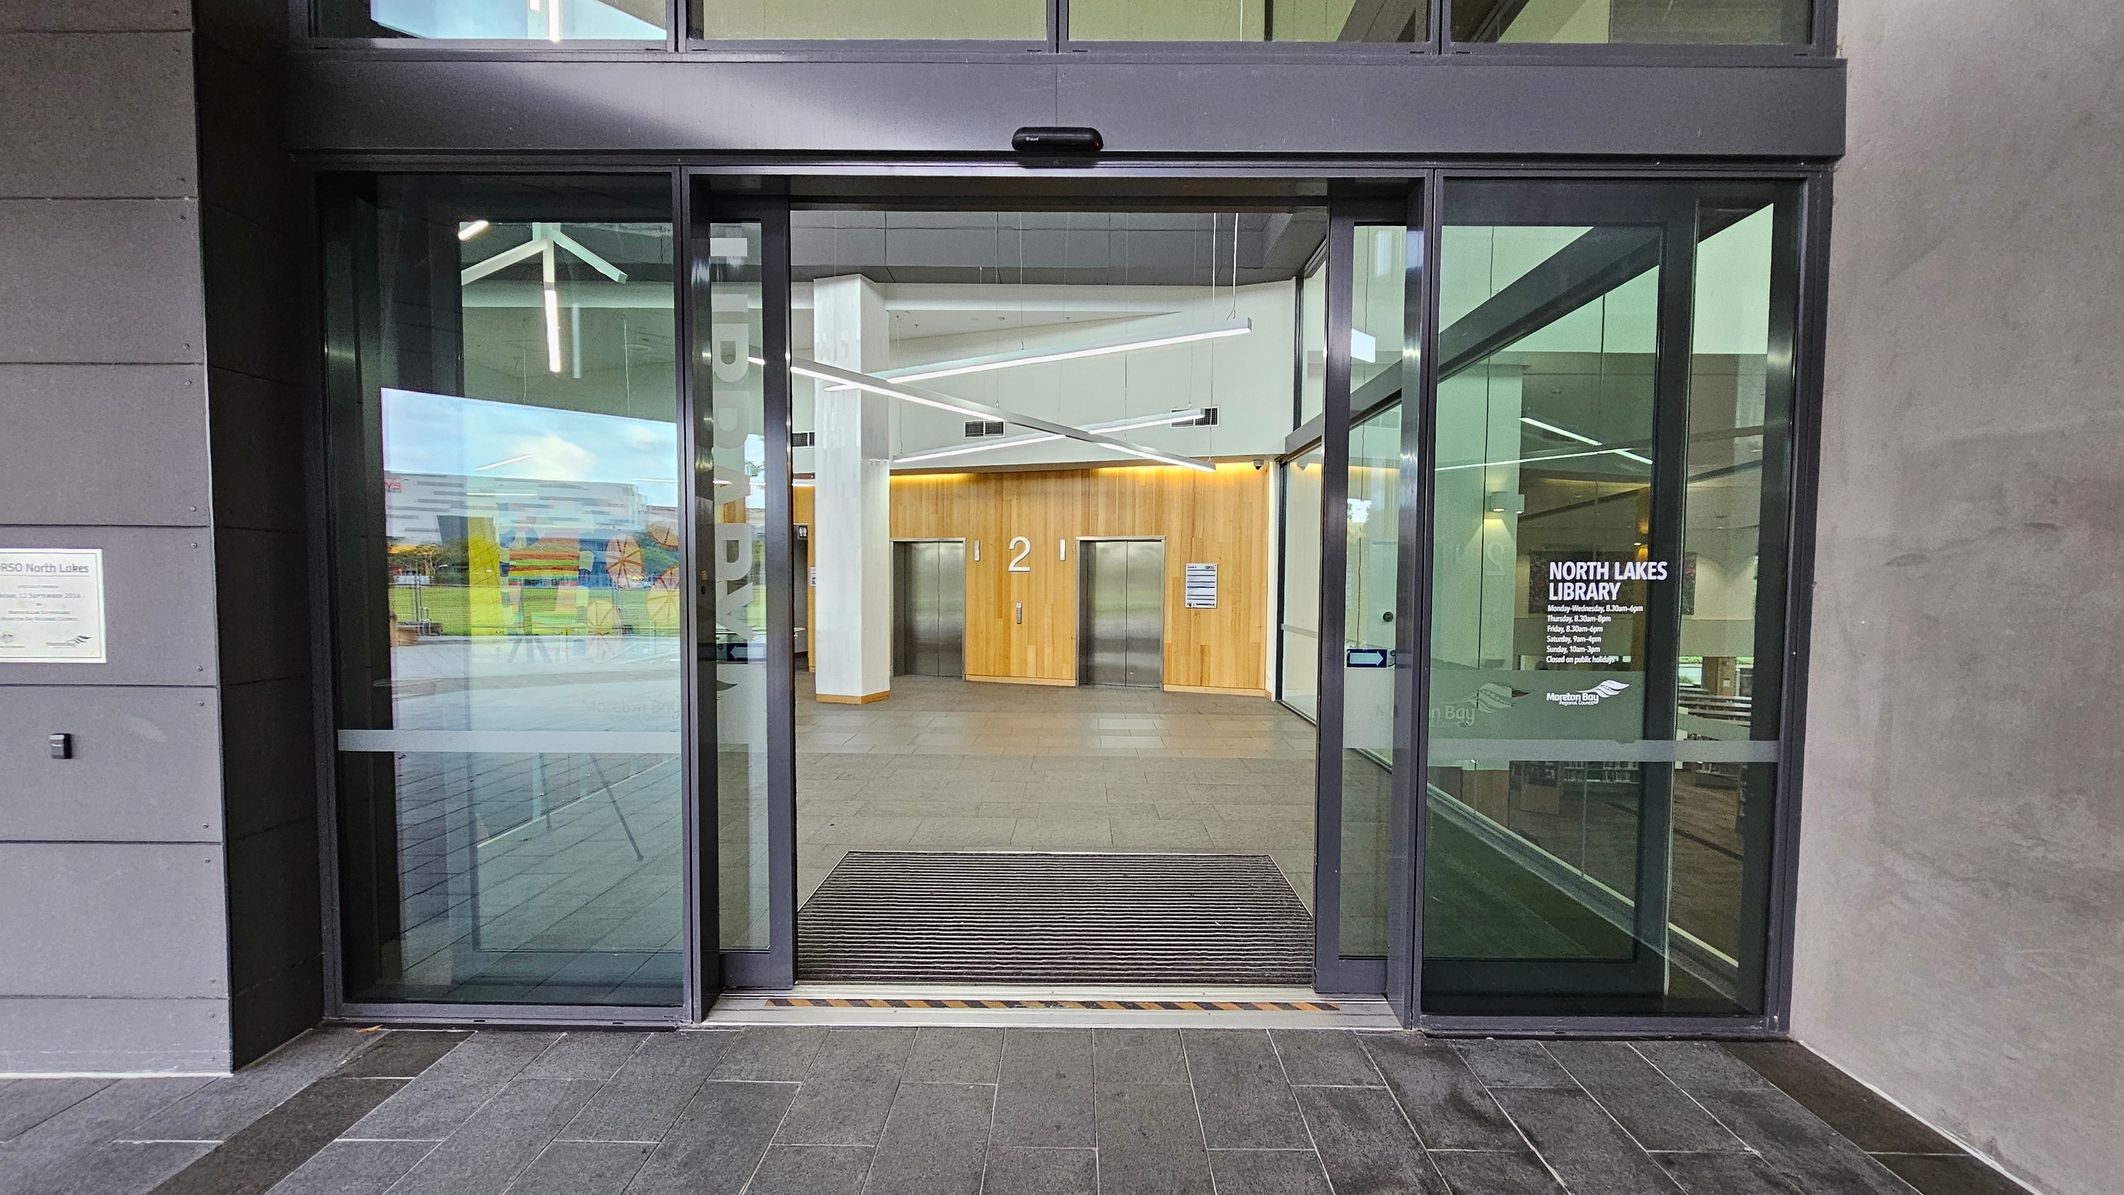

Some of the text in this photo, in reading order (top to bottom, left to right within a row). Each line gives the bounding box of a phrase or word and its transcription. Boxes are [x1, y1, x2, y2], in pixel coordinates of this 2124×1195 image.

[1008, 536, 1031, 572] 2
[26, 562, 57, 573] North
[59, 563, 89, 573] Lakes
[1549, 561, 1668, 580] NORTH LAKES
[1548, 582, 1621, 600] LIBRARY
[1547, 604, 1643, 613] Monday-Wednesday, 8.30am-6pm
[1547, 615, 1573, 623] Thursday,
[1547, 625, 1603, 633] Friday, 8.30am-6pm
[1546, 635, 1601, 644] Saturday, 9am-4pm
[1546, 645, 1600, 654] Sunday, 10am-3pm
[1546, 655, 1565, 663] Closed
[1574, 655, 1591, 664] public
[1592, 655, 1615, 664] holidays
[1546, 692, 1600, 704] Moreton Bay
[1445, 705, 1476, 726] Bay
